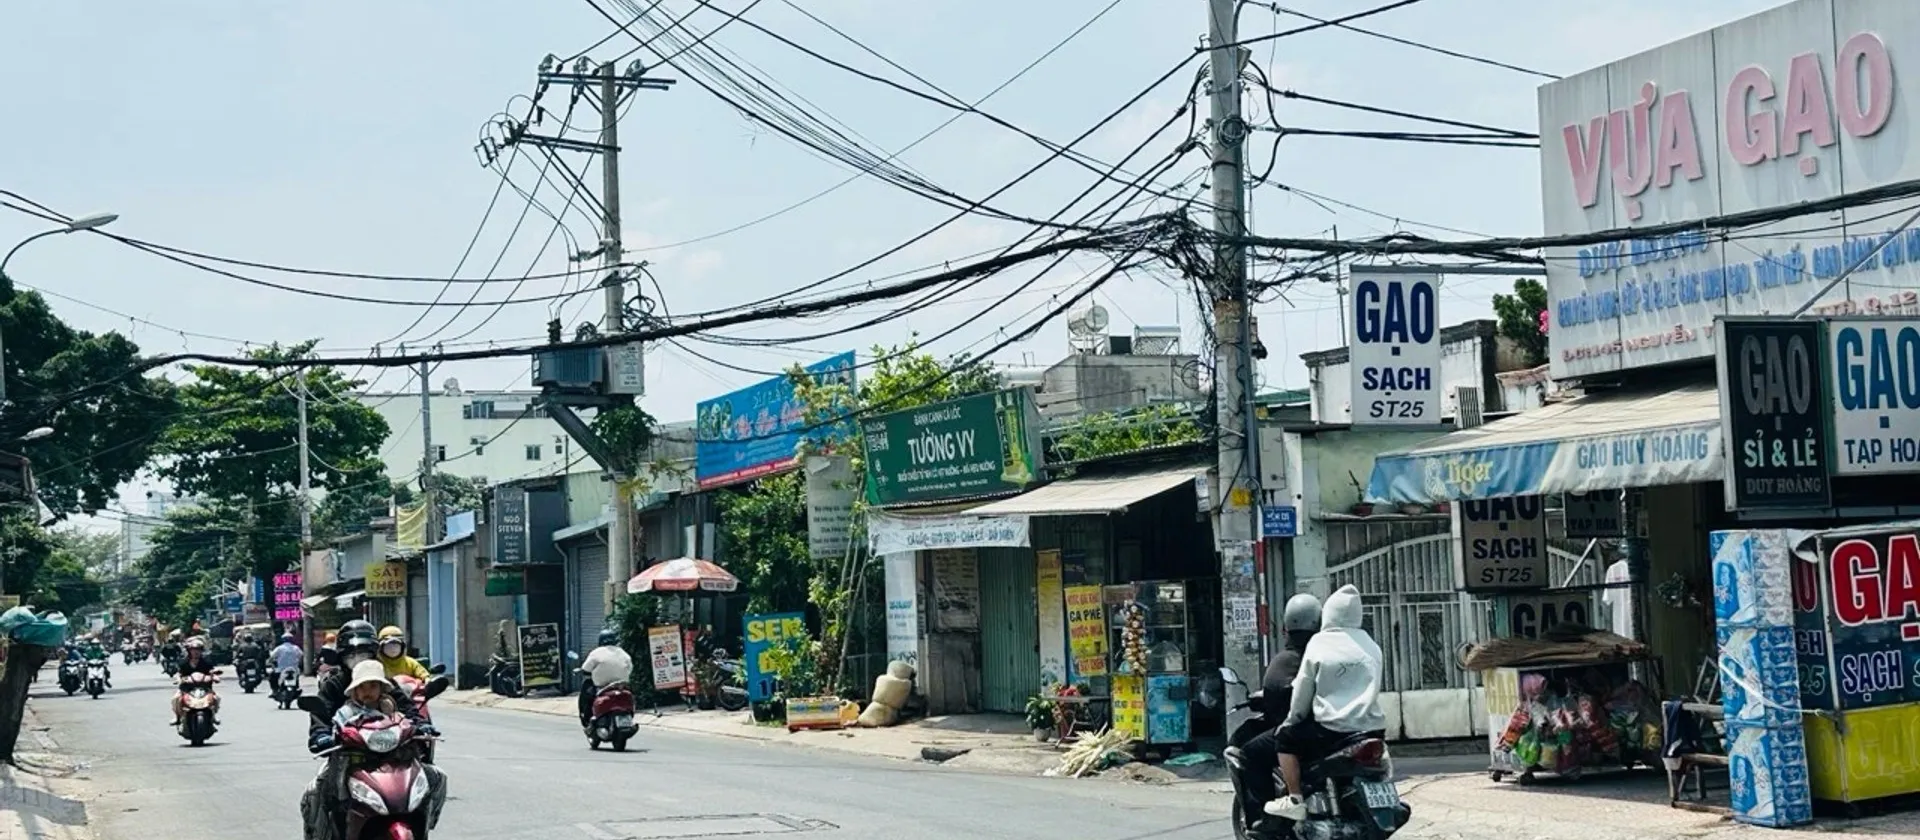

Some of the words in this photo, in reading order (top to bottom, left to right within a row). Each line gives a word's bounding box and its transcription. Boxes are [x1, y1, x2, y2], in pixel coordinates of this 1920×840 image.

[1562, 80, 1703, 221] VỰA
[1725, 32, 1893, 178] GẠO
[1356, 280, 1434, 356] GẠO
[1625, 323, 1697, 352] NGUYỄN
[1363, 367, 1431, 396] SẠCH
[1740, 334, 1811, 431] GẠO
[1837, 327, 1920, 429] GẠO
[1370, 401, 1424, 418] ST25
[908, 427, 955, 465] TƯỜNG
[956, 429, 975, 458] VY
[1577, 441, 1607, 476] GẠO
[1612, 437, 1646, 466] HUY
[1744, 429, 1765, 467] SỈ
[1771, 439, 1788, 467] &
[1793, 428, 1817, 466] LẺ
[1844, 439, 1883, 469] TẠP
[1890, 438, 1920, 463] HO
[1446, 458, 1493, 495] Tiger
[1746, 478, 1774, 494] DUY
[1777, 474, 1821, 494] HOÀNG
[1472, 537, 1537, 564] SẠCH
[1481, 567, 1532, 583] ST25
[1841, 650, 1904, 702] SẠCH
